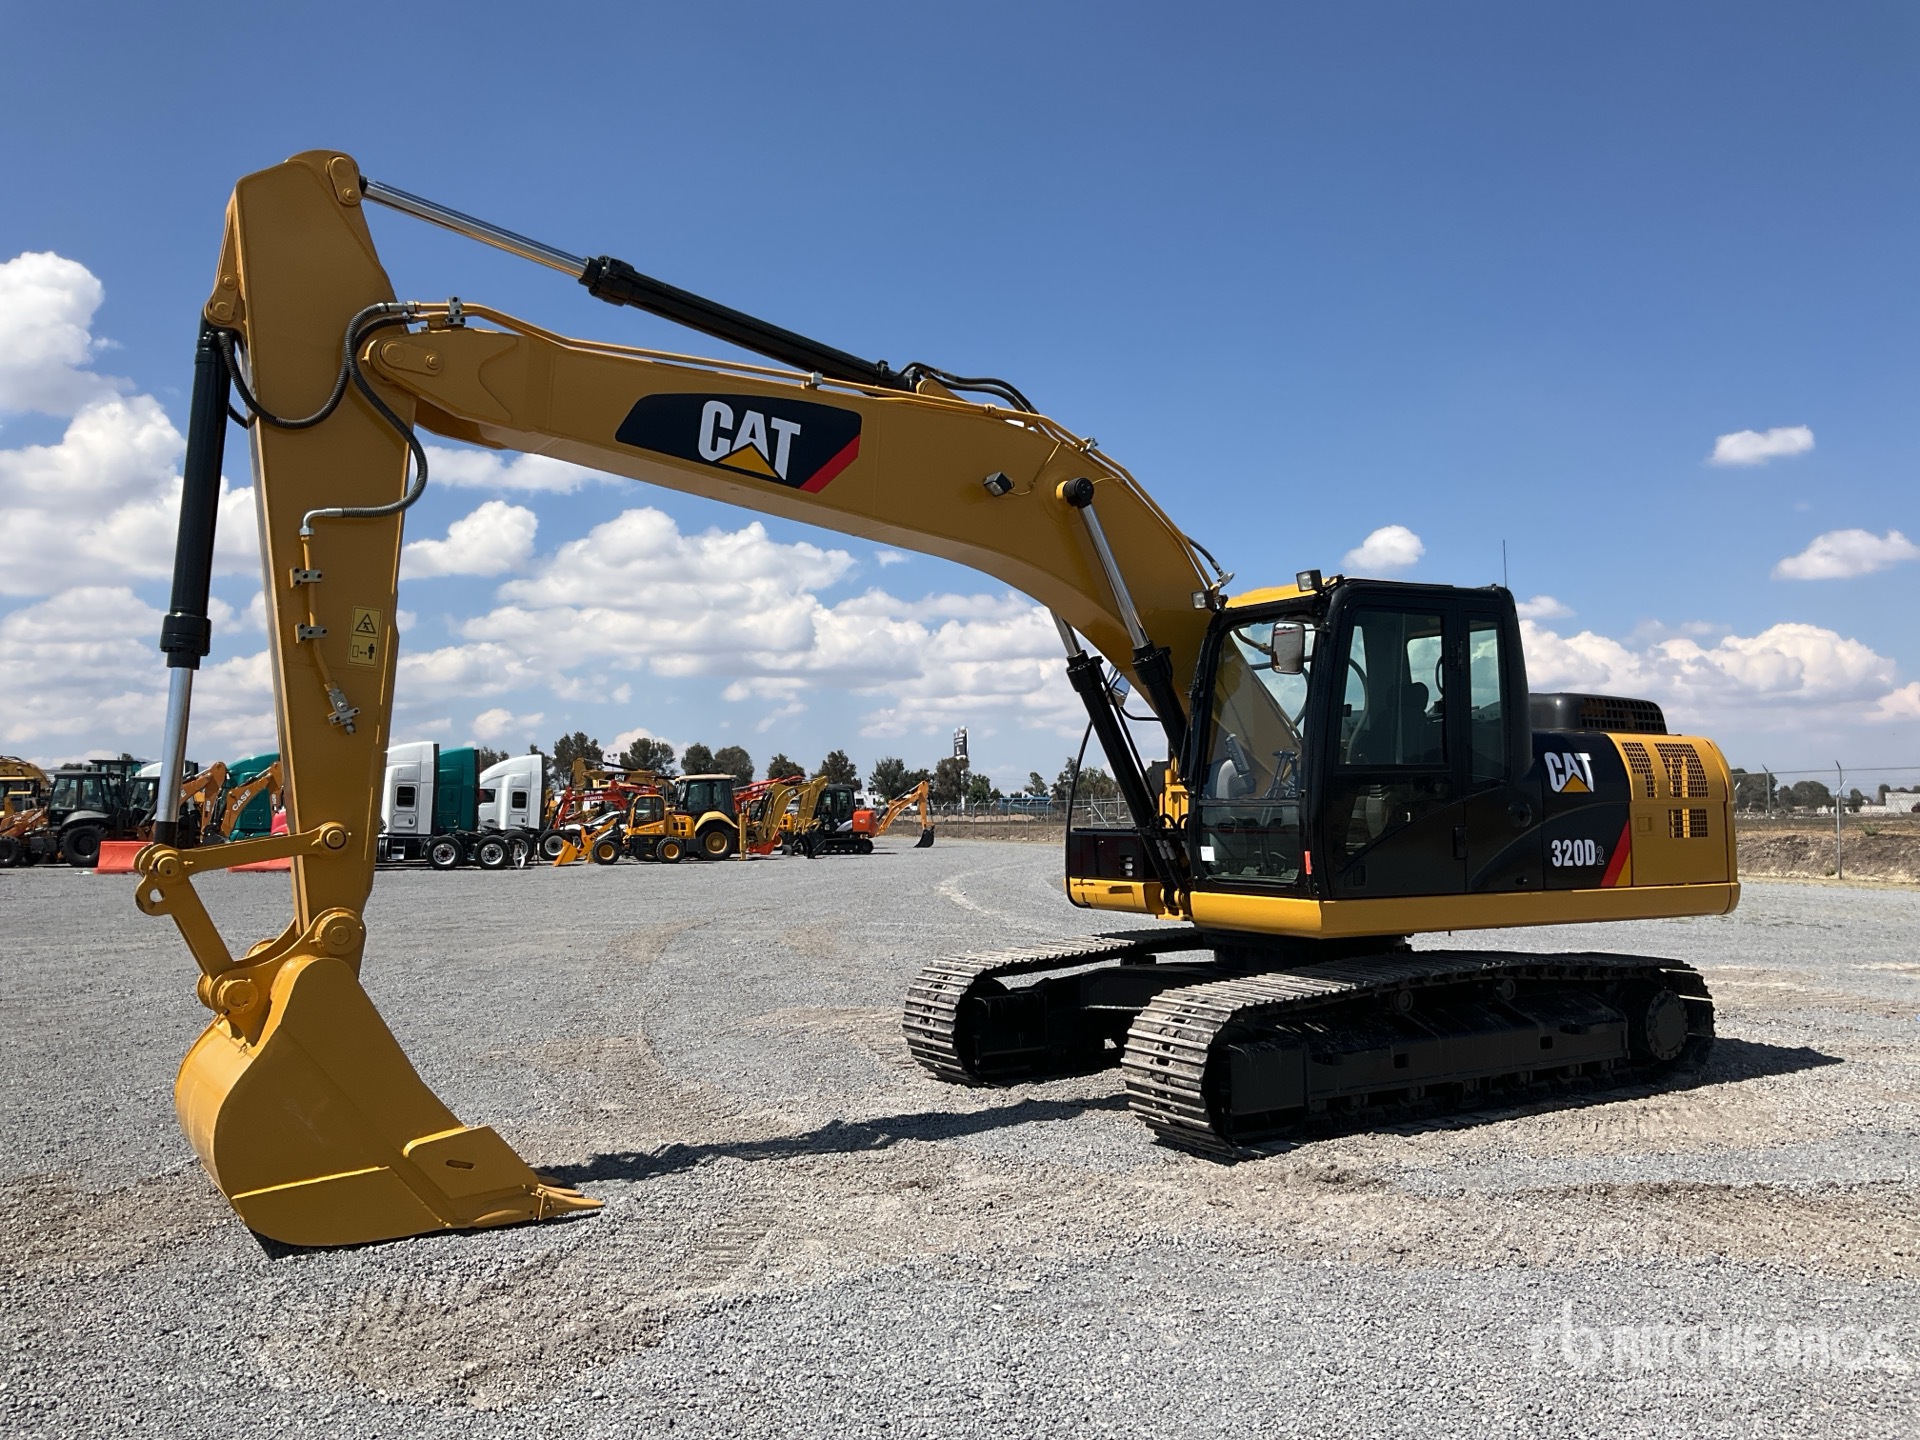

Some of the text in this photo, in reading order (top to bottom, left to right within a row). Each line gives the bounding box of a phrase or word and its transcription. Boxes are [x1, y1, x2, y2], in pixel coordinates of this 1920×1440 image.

[698, 400, 801, 480] CAT
[614, 773, 626, 782] CAT
[1544, 751, 1594, 793] CAT
[232, 789, 252, 811] CASE
